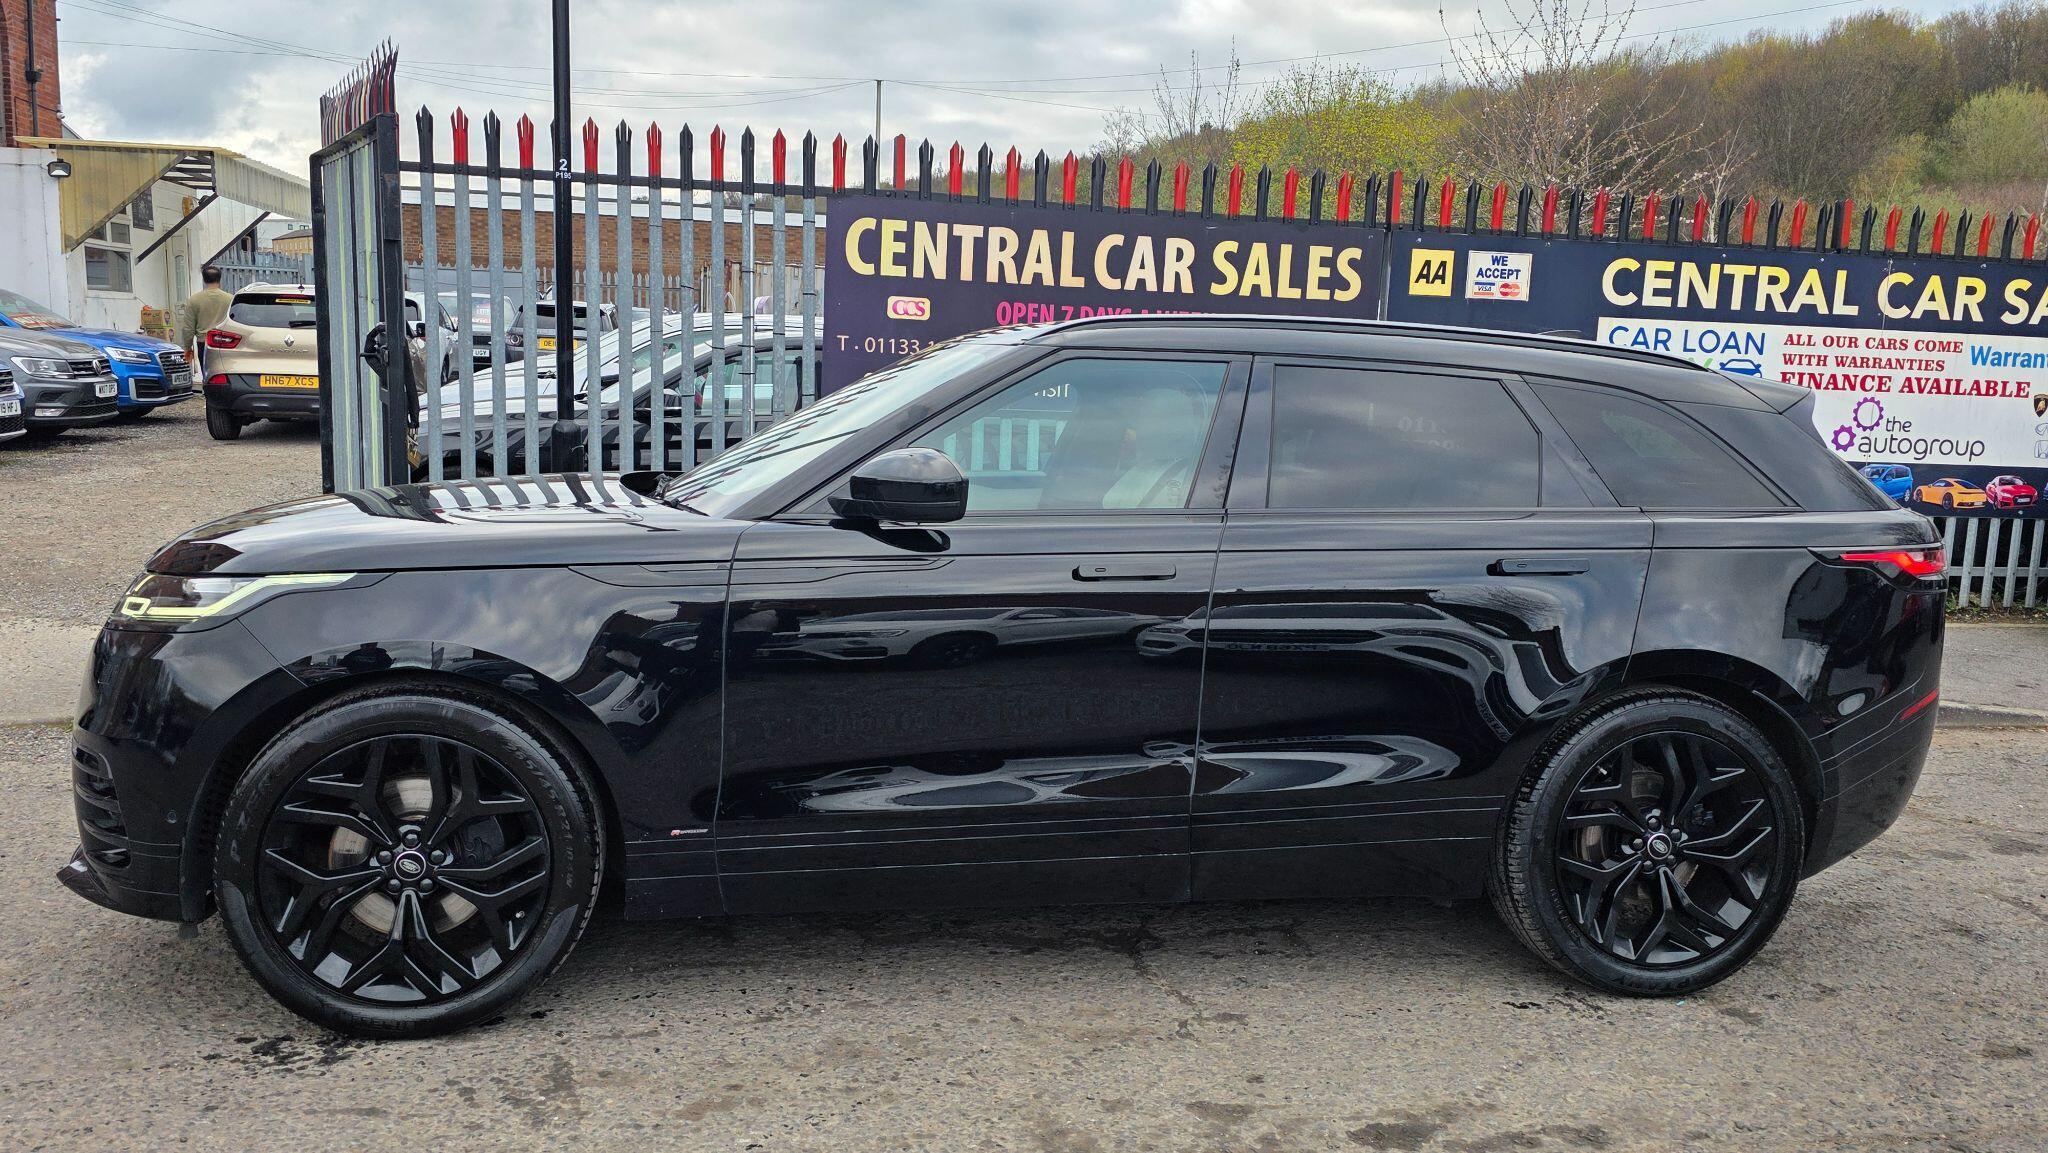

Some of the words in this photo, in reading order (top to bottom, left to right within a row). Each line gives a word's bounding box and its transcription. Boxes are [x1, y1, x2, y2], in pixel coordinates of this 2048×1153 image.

[845, 217, 1085, 288] CENTRAL
[1094, 233, 1196, 294] CAR
[1210, 240, 1363, 302] SALES
[1414, 259, 1448, 285] AA
[1491, 254, 1509, 267] WE
[1476, 267, 1522, 280] ACCEPT
[1601, 257, 1859, 316] CENTRAL
[1877, 271, 1987, 323] CAR
[996, 301, 1055, 326] OPEN
[1060, 305, 1075, 321] 7
[1608, 325, 1672, 351] CAR
[1682, 328, 1766, 356] LOAN
[1783, 333, 1817, 347] ALL
[1822, 335, 1859, 349] OUR
[1864, 336, 1909, 351] CARS
[1914, 339, 1964, 354] COME
[1782, 353, 1829, 367] WITH
[1834, 355, 1946, 372] WARRANTIES
[264, 376, 291, 385] HN67
[294, 376, 314, 386] XCS
[1780, 371, 1892, 393] FINANCE
[1898, 376, 2031, 399] AVAILABLE
[1885, 415, 1912, 433] the
[1858, 432, 1985, 462] autogroup
